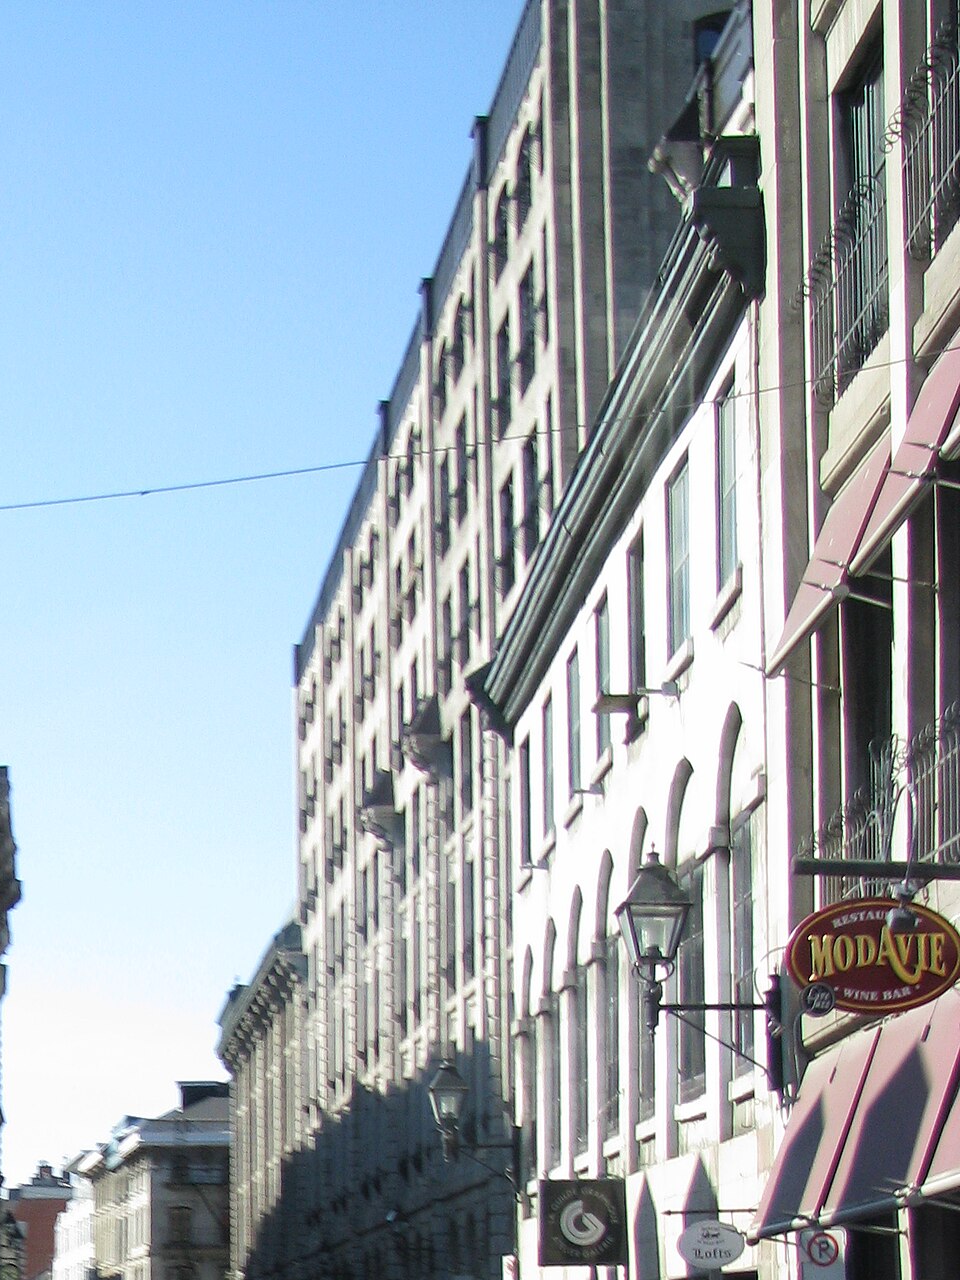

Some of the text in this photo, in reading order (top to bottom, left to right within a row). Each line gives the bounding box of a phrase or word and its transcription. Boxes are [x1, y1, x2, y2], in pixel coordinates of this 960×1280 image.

[832, 910, 922, 928] RESTAUT
[808, 924, 946, 985] MODAVIE
[843, 987, 878, 1000] WINE
[883, 985, 911, 1000] BAR
